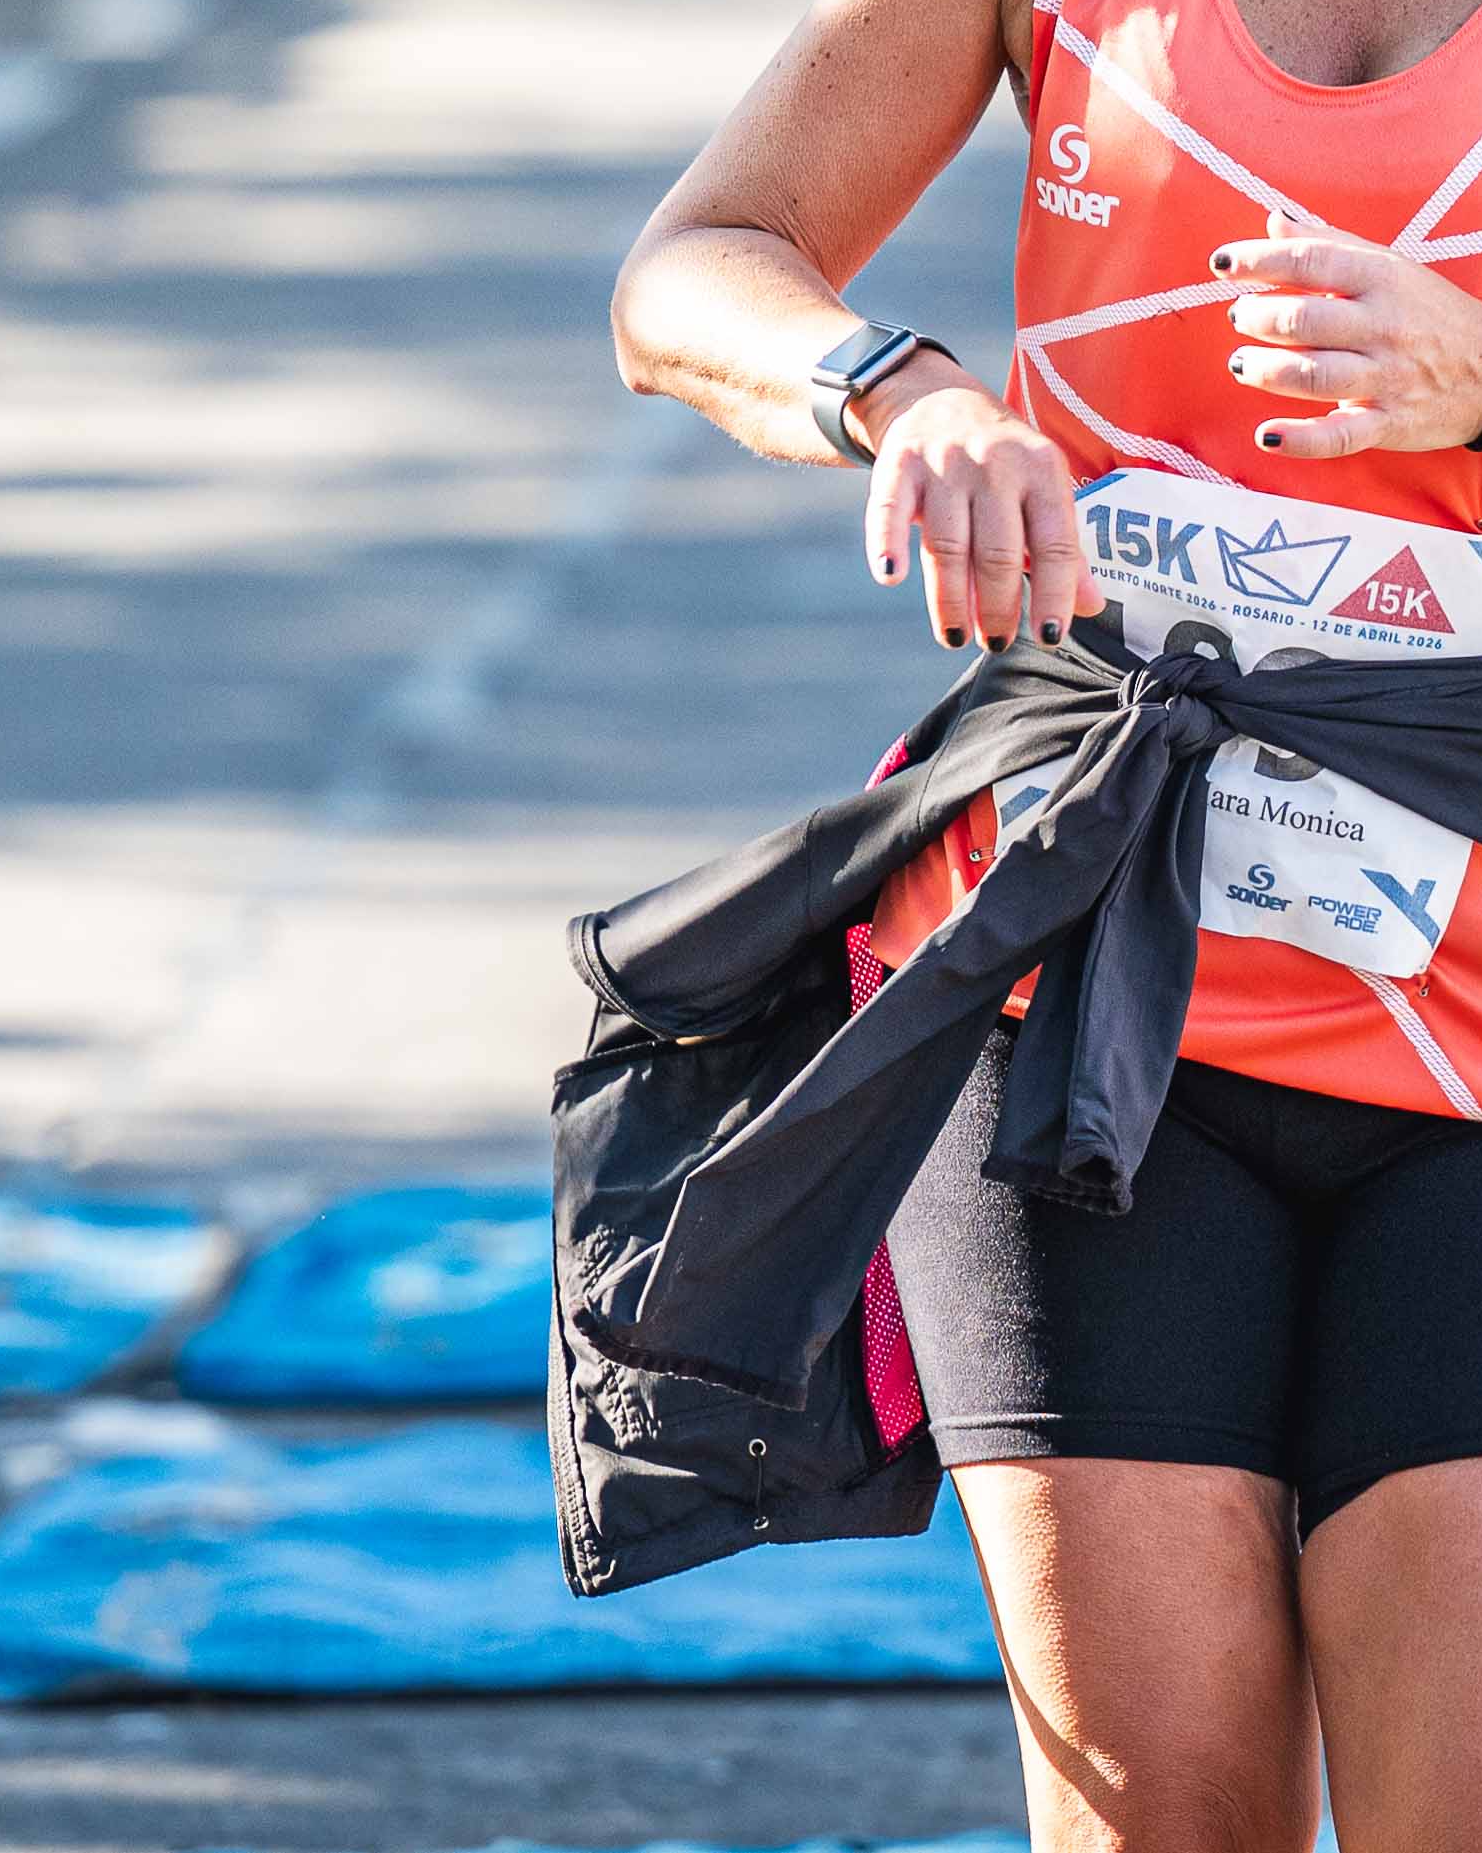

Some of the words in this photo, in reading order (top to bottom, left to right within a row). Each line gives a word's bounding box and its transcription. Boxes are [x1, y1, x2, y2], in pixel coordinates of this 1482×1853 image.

[1086, 504, 1204, 584] 15K
[1090, 565, 1139, 586] PUERTO
[1143, 579, 1182, 600] NORTE
[1186, 593, 1216, 611] 2026
[1232, 604, 1294, 626] ROSARIO
[1312, 619, 1327, 632] 12
[1334, 623, 1352, 636] DE
[1358, 627, 1401, 644] ABRIL
[1408, 635, 1443, 650] 2026
[1365, 580, 1431, 619] 15K
[1207, 790, 1250, 816] ara
[1259, 796, 1365, 842] Monica
[1308, 895, 1382, 921] POWER
